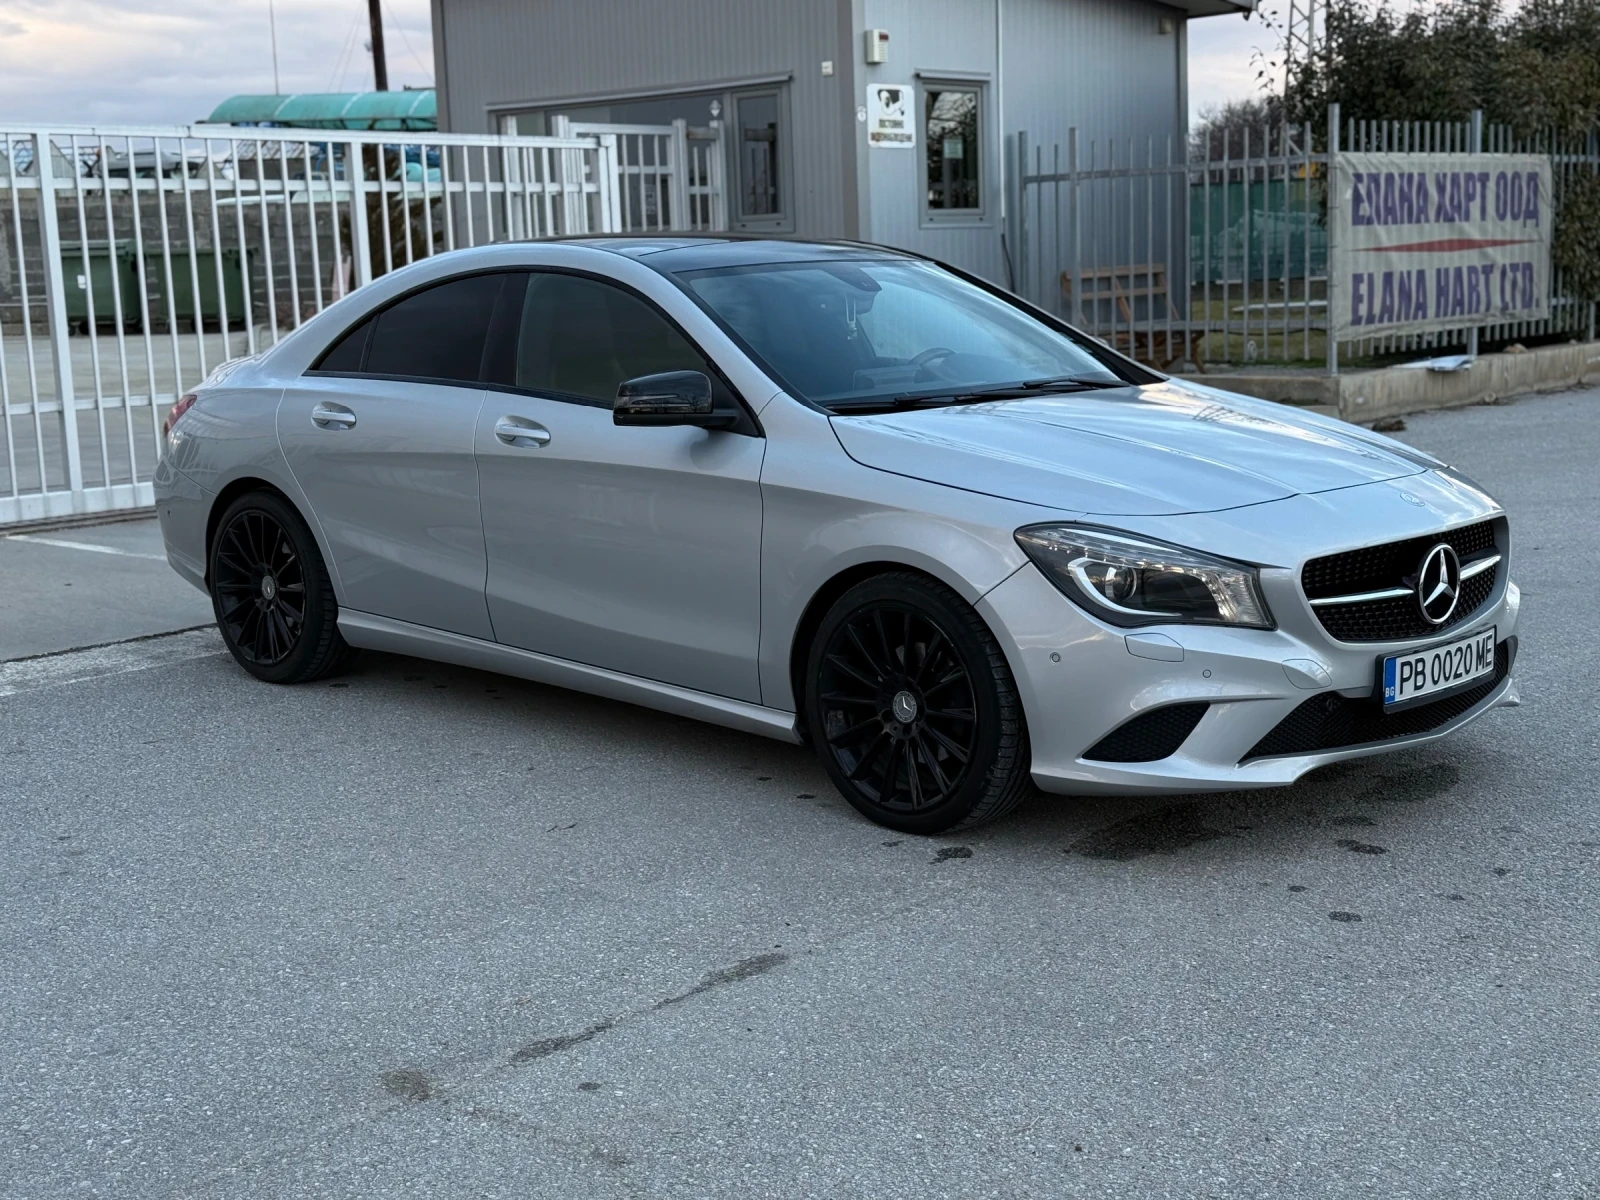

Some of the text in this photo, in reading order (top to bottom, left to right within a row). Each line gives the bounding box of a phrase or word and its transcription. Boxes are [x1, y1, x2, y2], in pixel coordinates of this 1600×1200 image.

[1352, 170, 1540, 229] ЕЛАНА ХАРТ ООД
[1350, 268, 1428, 327] ELANA
[1434, 264, 1495, 319] HART
[1385, 686, 1395, 698] BG
[1399, 632, 1493, 695] PB 0020 ME
